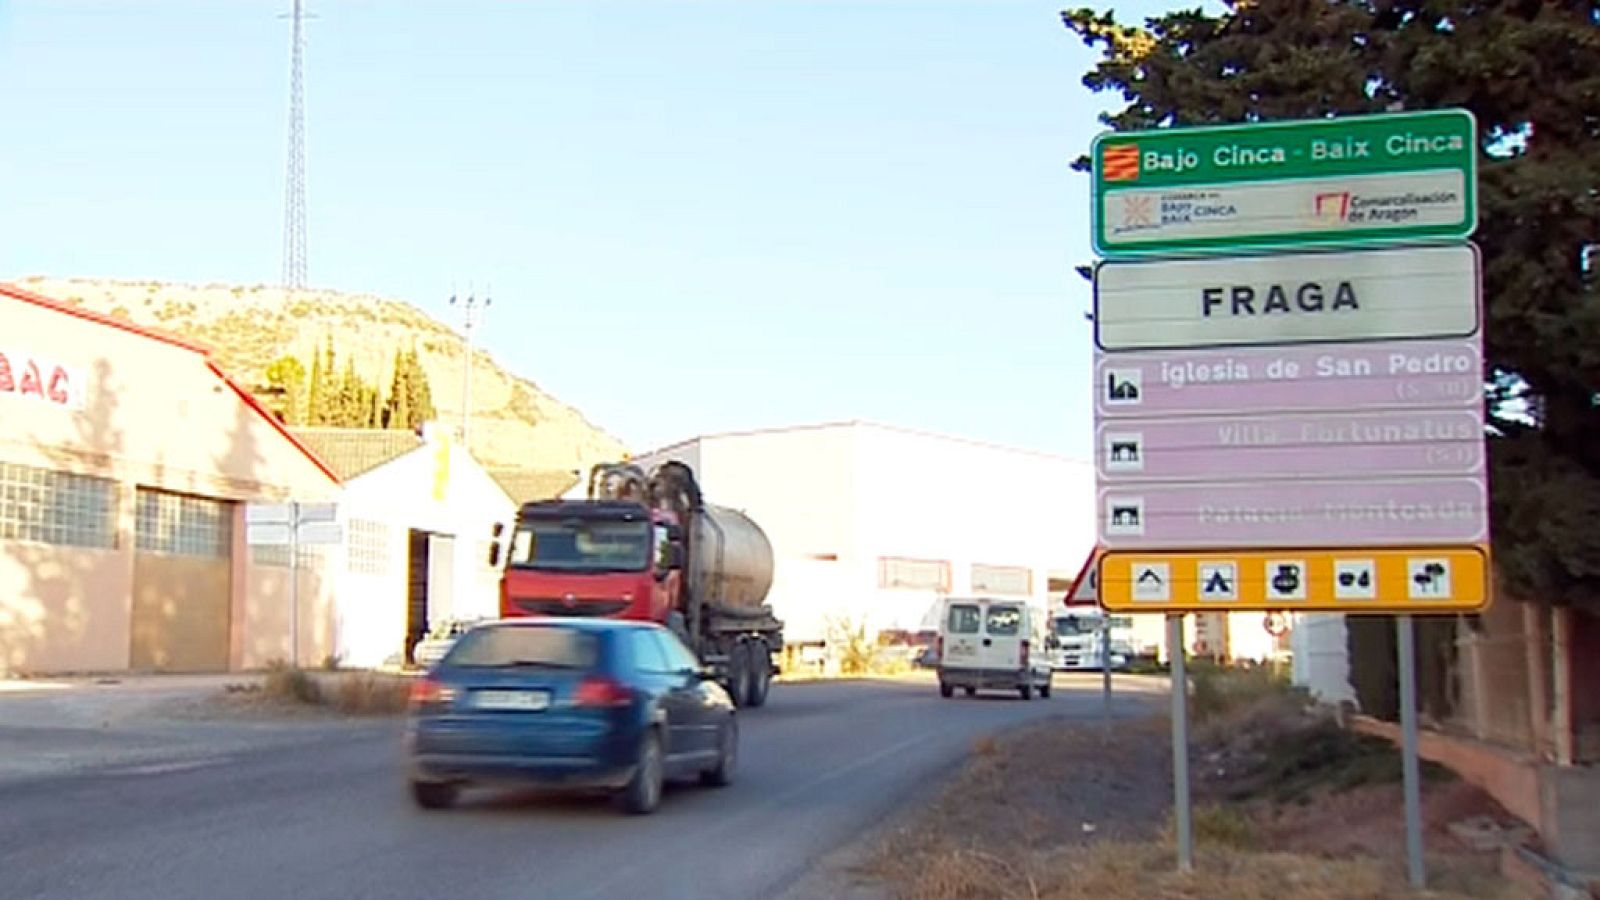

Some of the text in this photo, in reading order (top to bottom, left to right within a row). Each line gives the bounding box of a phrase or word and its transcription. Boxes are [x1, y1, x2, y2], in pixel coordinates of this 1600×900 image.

[1143, 149, 1198, 173] Bajo
[1213, 144, 1286, 167] Cinca
[1311, 138, 1369, 160] Baix
[1386, 132, 1463, 155] Cinca
[1194, 205, 1236, 216] CINCA
[1349, 210, 1364, 222] de
[1202, 282, 1359, 317] FRAGA
[1267, 360, 1299, 379] de
[1316, 355, 1371, 376] San
[1389, 350, 1471, 374] Pedro
[1218, 417, 1473, 445] Villa Fortunatus
